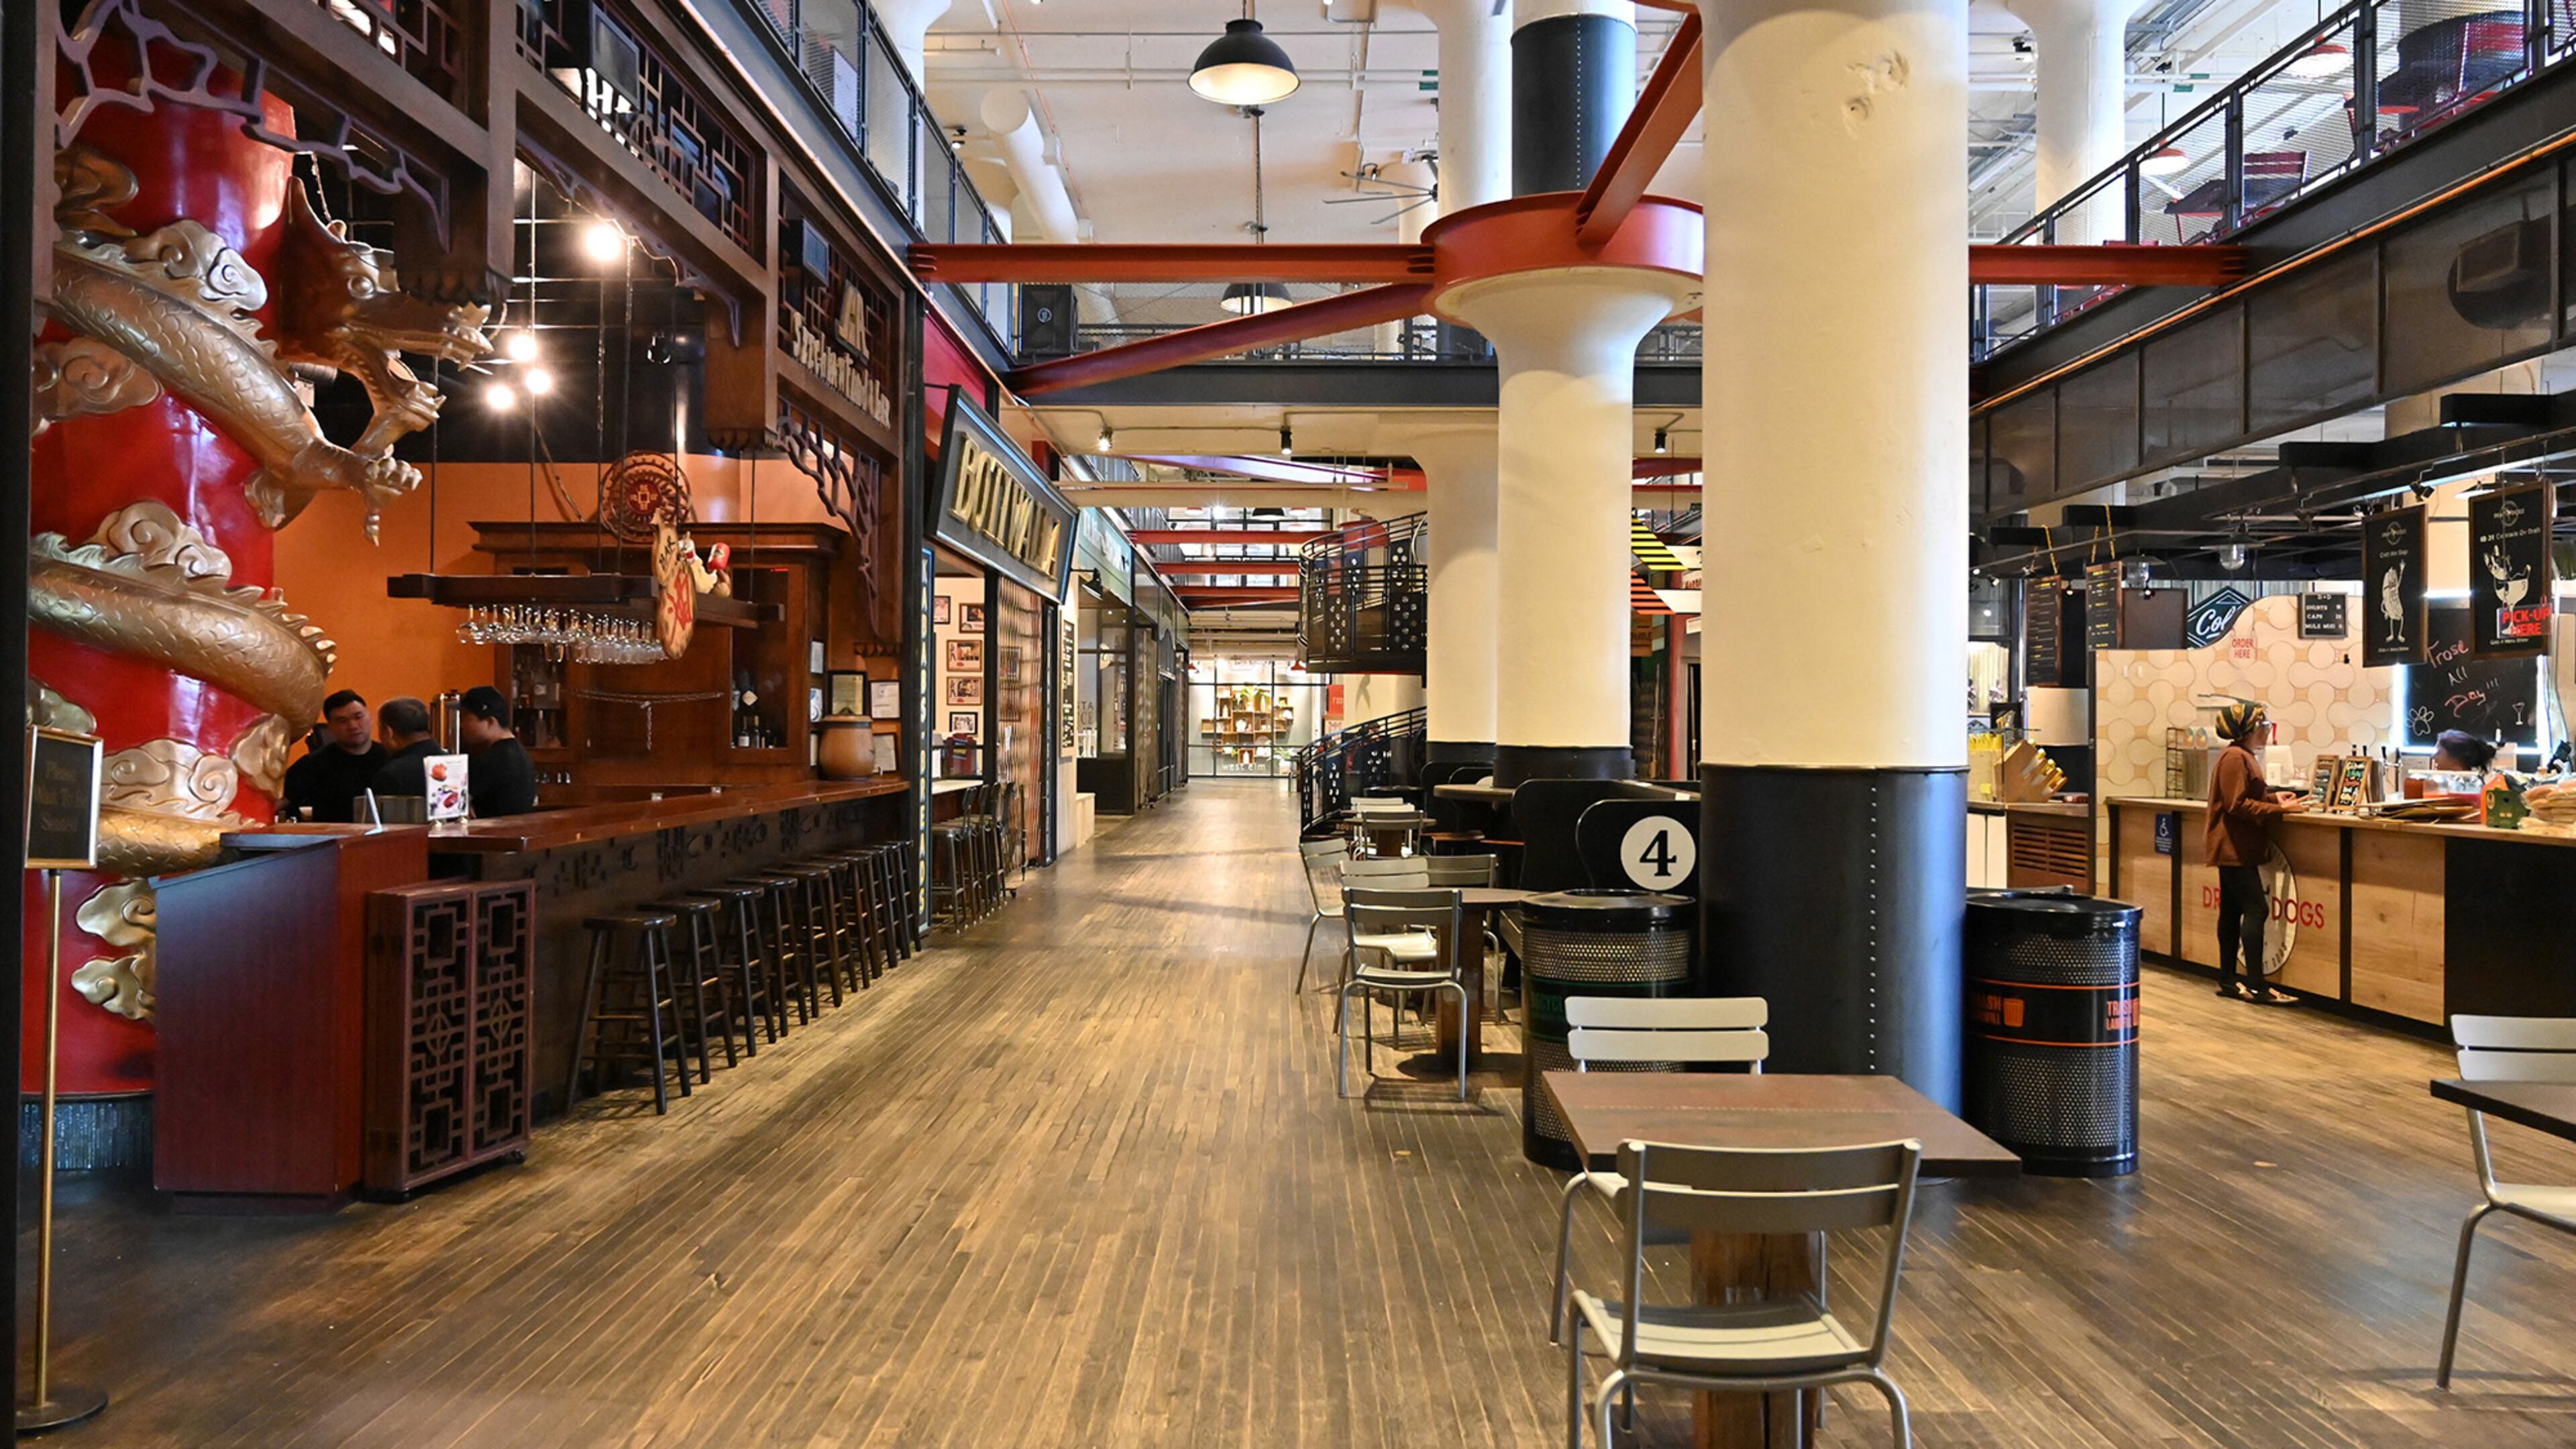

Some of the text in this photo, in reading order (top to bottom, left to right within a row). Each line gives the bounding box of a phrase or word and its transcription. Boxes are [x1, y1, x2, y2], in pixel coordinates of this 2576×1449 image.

[2196, 605, 2243, 636] Col
[2502, 606, 2551, 623] PICK-UP
[2511, 623, 2541, 637] HERE
[2232, 639, 2254, 648] ORDER
[2234, 649, 2251, 658] HERE
[1222, 762, 1267, 771] west elm
[1639, 830, 1677, 877] 4
[2271, 897, 2325, 930] DOGS
